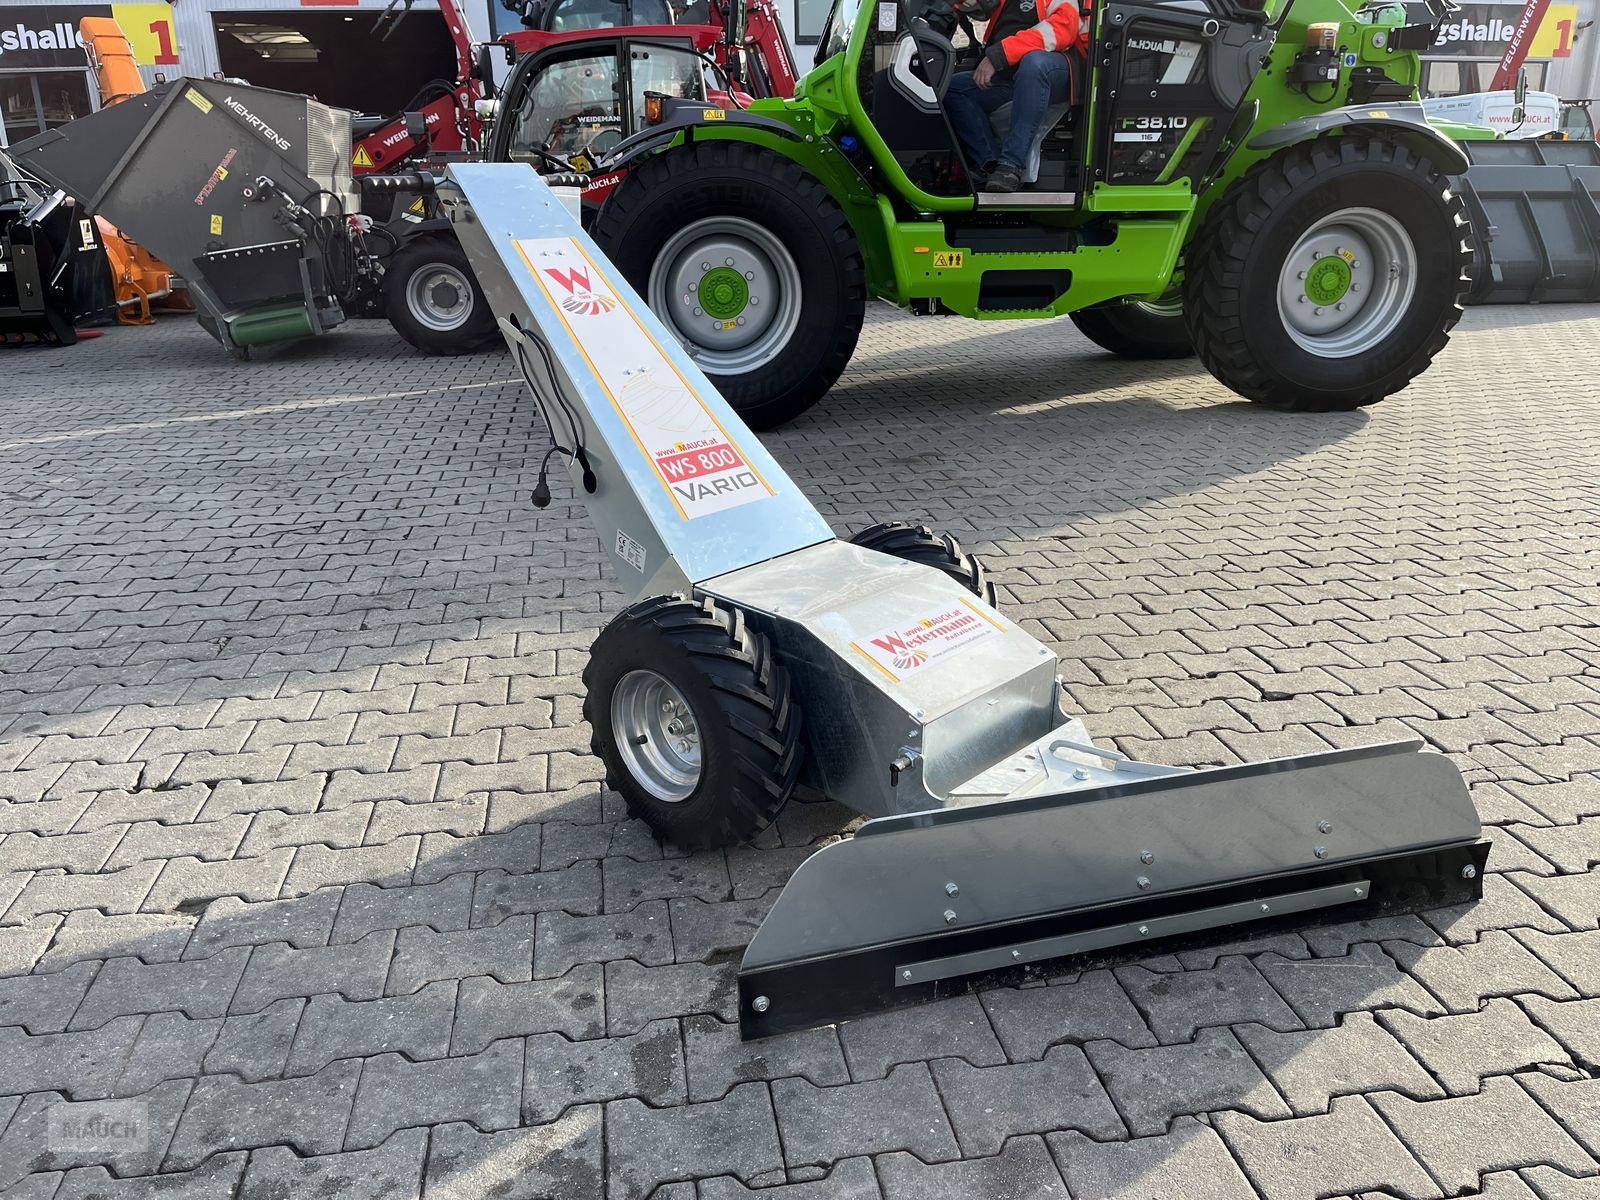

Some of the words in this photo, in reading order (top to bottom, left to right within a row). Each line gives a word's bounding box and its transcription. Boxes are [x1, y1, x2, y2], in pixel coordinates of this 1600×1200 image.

[0, 23, 86, 54] shall
[150, 20, 179, 64] 1
[1552, 20, 1571, 57] 1
[224, 96, 291, 150] MEHRTENS
[383, 112, 440, 147] WEIDNN
[1122, 116, 1187, 129] F38.10
[580, 175, 620, 193] AUCH.at
[661, 457, 698, 479] WS
[697, 448, 736, 470] 800
[672, 471, 759, 502] VARIO
[870, 614, 976, 655] Westermann
